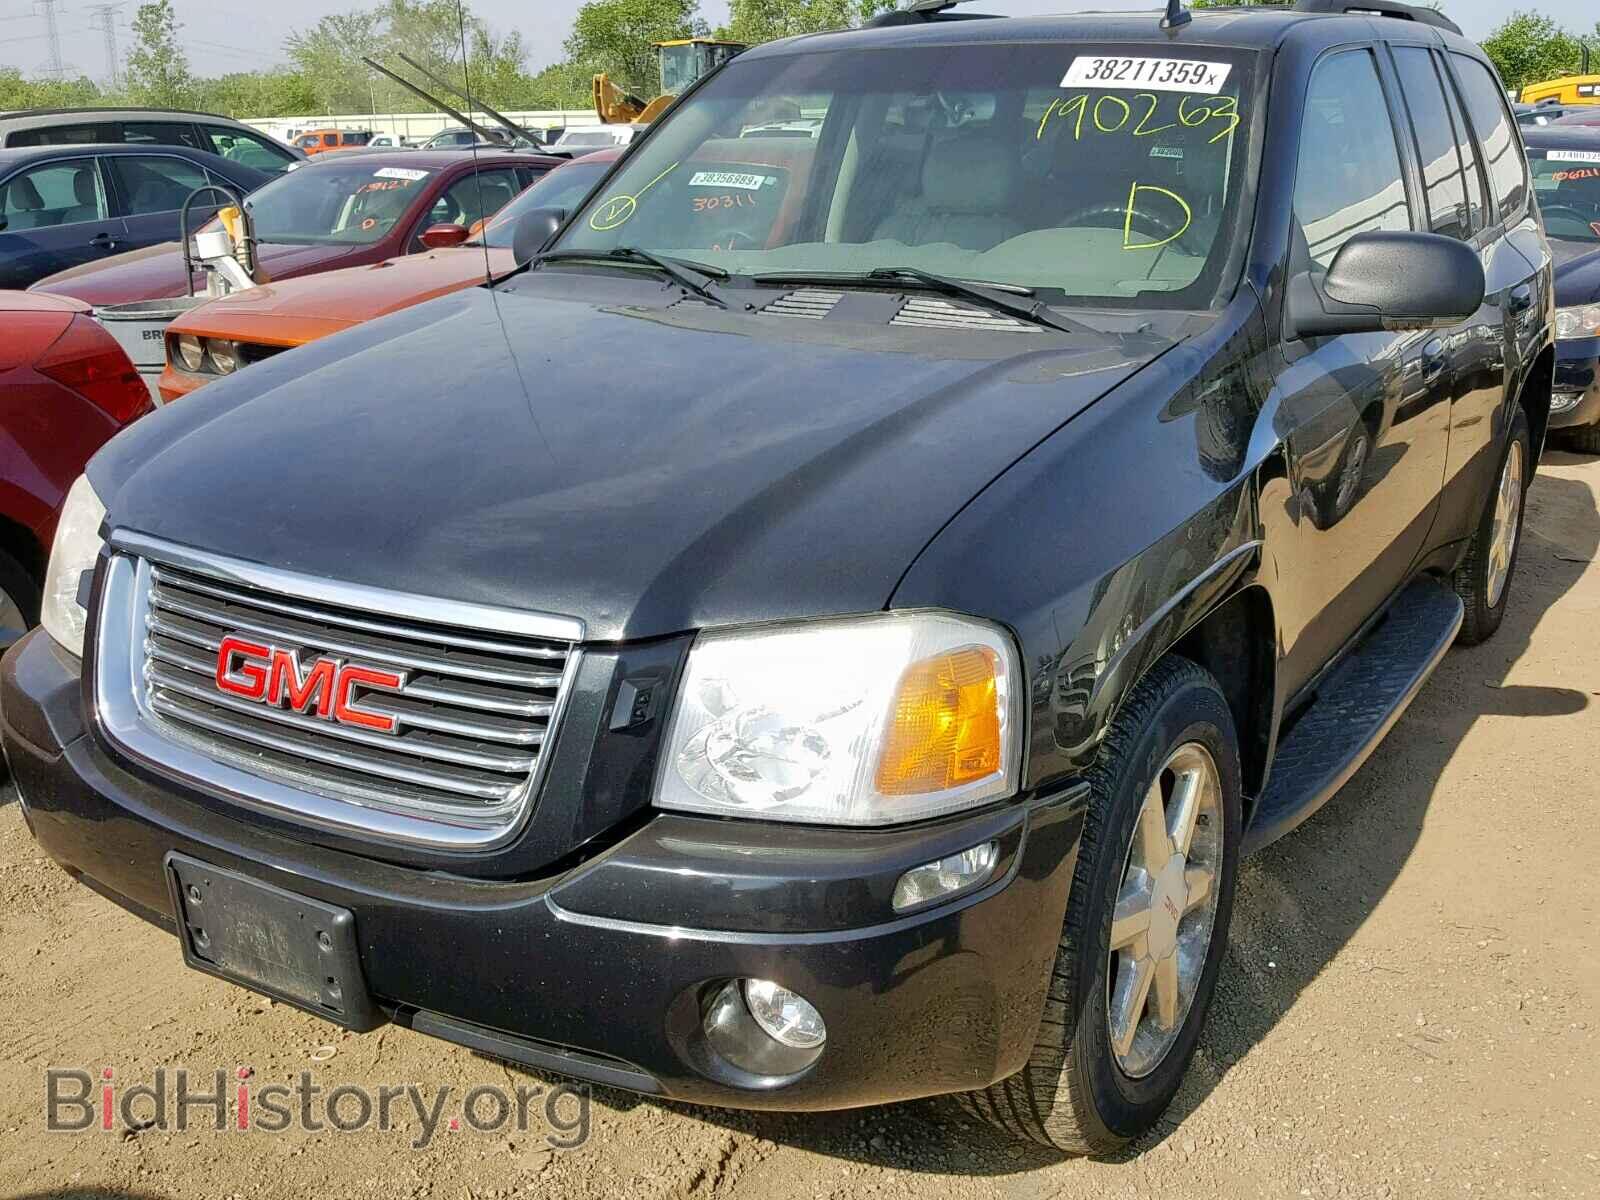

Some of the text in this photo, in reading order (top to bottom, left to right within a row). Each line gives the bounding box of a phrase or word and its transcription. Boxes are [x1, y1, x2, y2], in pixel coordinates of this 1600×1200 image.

[1123, 181, 1192, 250] D
[142, 330, 165, 340] BR
[216, 634, 407, 735] GMC
